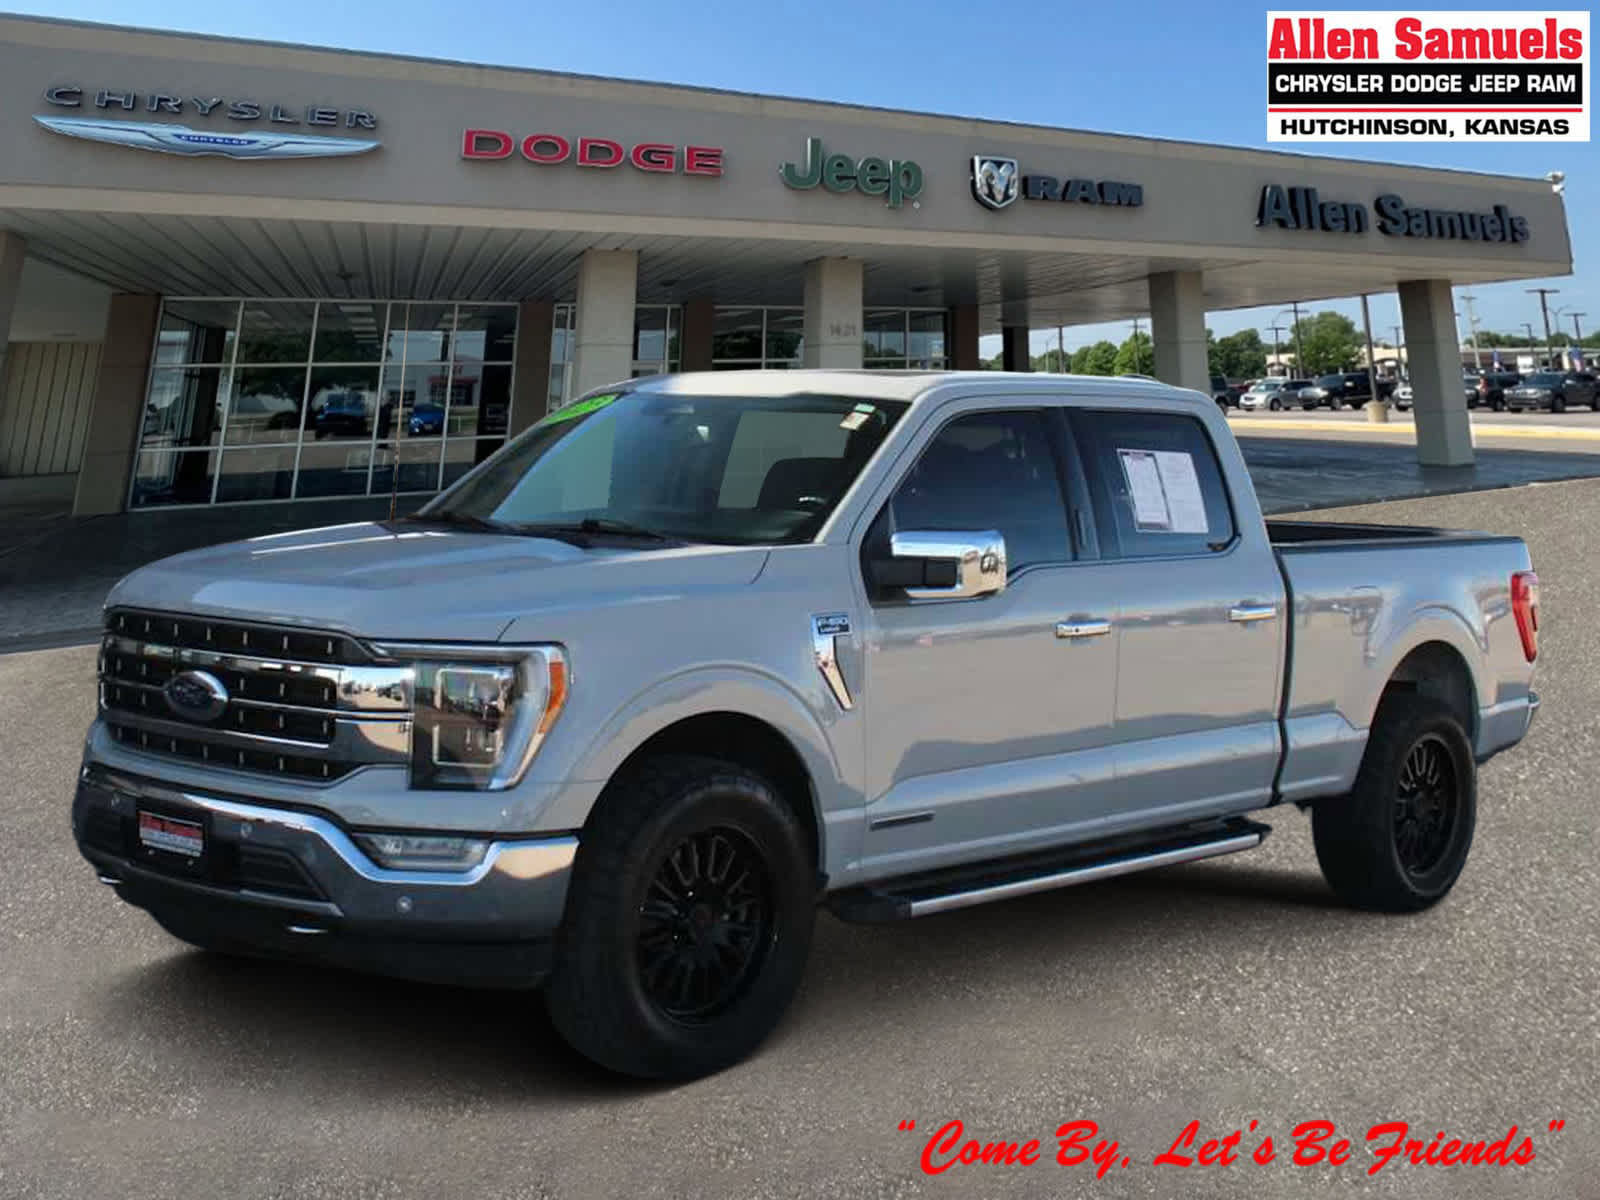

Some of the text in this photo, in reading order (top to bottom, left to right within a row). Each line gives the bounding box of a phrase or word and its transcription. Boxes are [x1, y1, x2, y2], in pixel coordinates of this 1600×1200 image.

[44, 87, 379, 130] CHRYSLER
[462, 127, 725, 177] DODGE
[780, 137, 924, 208] Jeep
[1023, 175, 1144, 208] RAM
[1257, 183, 1530, 244] Allen Samuels
